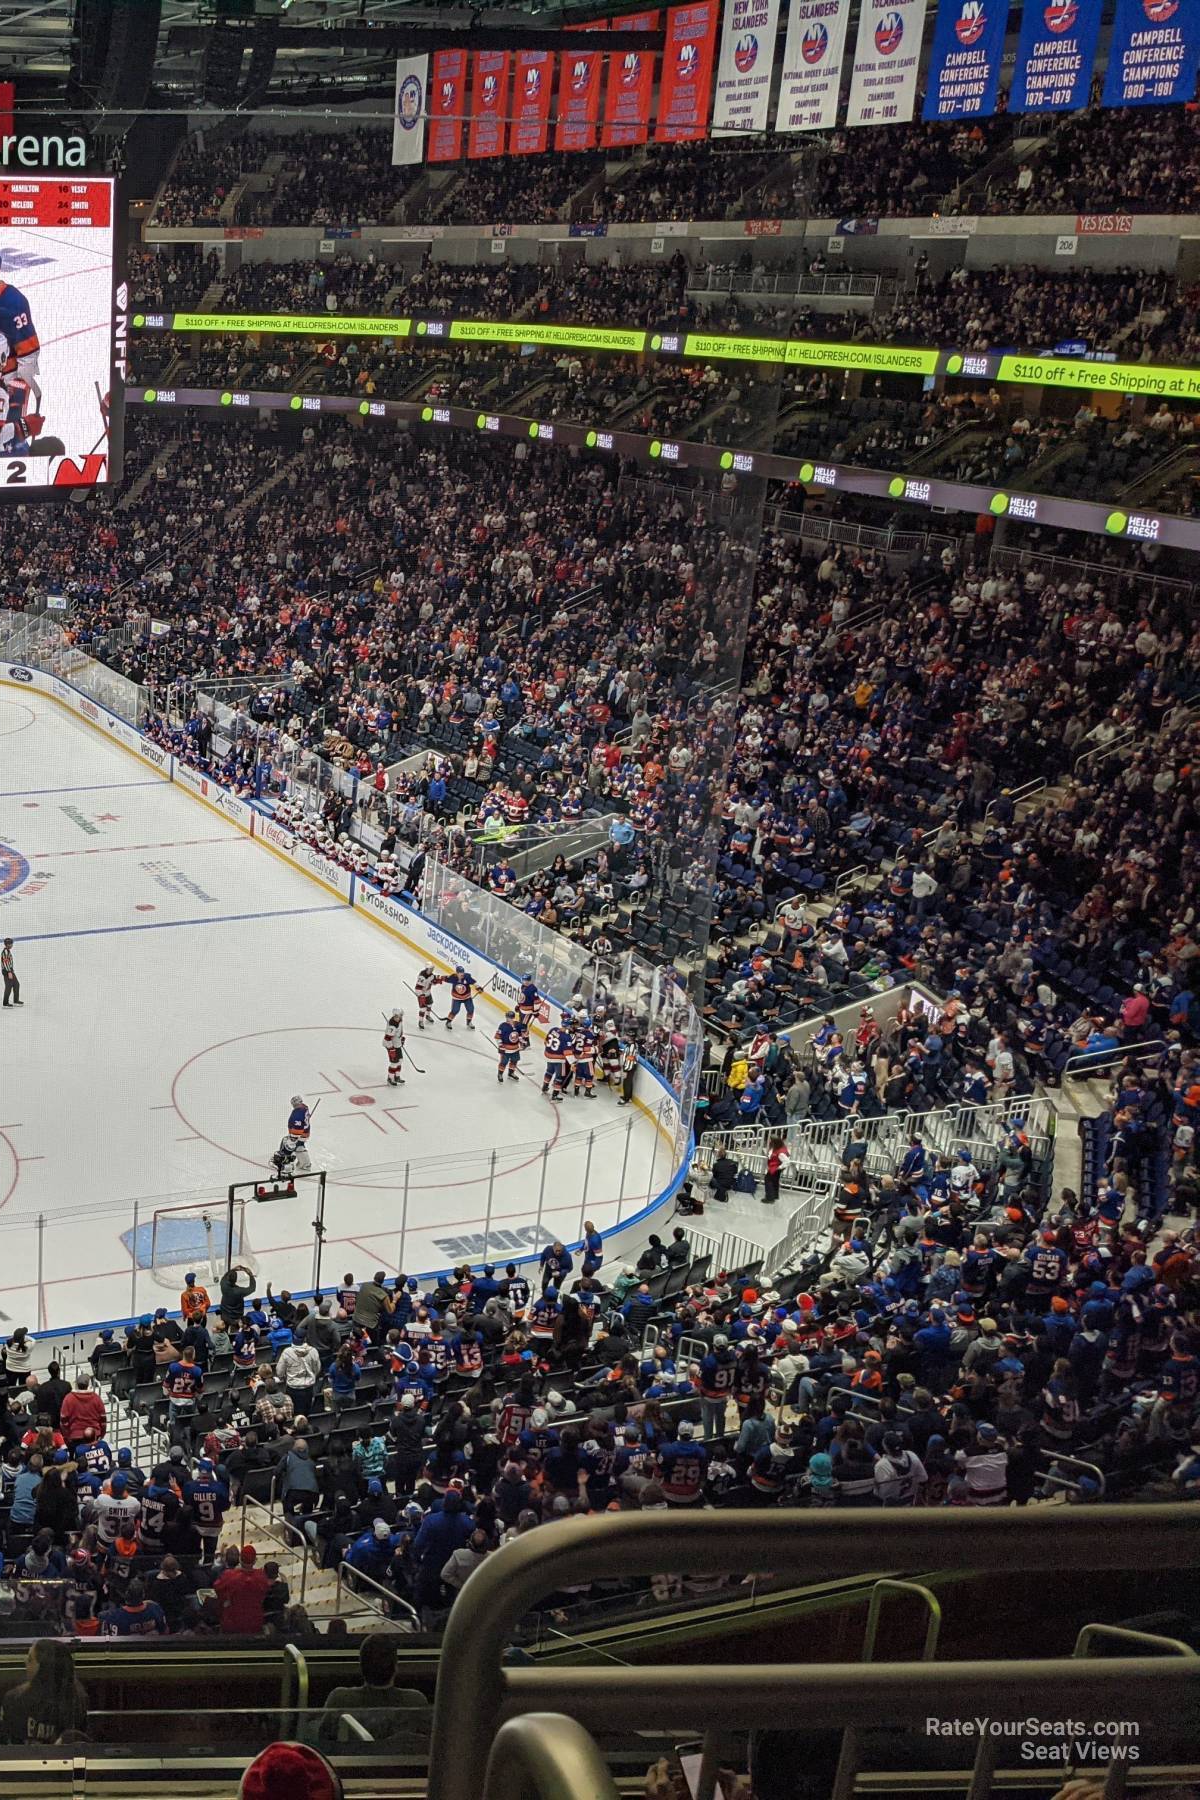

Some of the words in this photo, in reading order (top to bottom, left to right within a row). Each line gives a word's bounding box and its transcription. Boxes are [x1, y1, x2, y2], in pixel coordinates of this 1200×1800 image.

[800, 5, 839, 19] ISLANDERS
[732, 15, 768, 30] ISLANDERS
[1130, 28, 1182, 47] CAMPBELL
[1033, 39, 1077, 56] CAMPBELL
[1123, 45, 1185, 65] CONFERENCE
[855, 62, 877, 72] NATIONAL
[878, 60, 897, 70] HOCKEY
[898, 57, 917, 68] LEAGUE
[945, 53, 986, 66] CAMPBELL
[1026, 55, 1081, 73] CONFERENCE
[939, 65, 990, 82] CONFERENCE
[1122, 63, 1179, 82] CHAMPIONS
[1026, 73, 1076, 89] CHAMPIONS
[868, 91, 895, 102] CHAMPIONS
[939, 81, 985, 98] CHAMPIONS
[795, 99, 819, 109] CHAMPIONS
[11, 185, 39, 193] HAMILTON
[1080, 216, 1097, 231] YES
[1098, 216, 1114, 232] YES
[1116, 216, 1132, 232] YES
[1059, 241, 1073, 251] 206
[14, 313, 28, 328] 33
[205, 319, 218, 327] OFF
[227, 319, 245, 328] FREE
[247, 320, 281, 329] SHIPPING
[477, 328, 490, 337] OFF
[497, 328, 513, 337] FREE
[515, 329, 544, 339] SHIPPING
[545, 331, 551, 340] AT
[695, 341, 711, 351] $110
[712, 342, 726, 352] OFF
[733, 344, 750, 354] FREE
[751, 345, 785, 357] SHIPPING
[788, 348, 798, 358] AT
[964, 357, 987, 367] HELLO
[962, 365, 986, 375] FRESH
[1013, 364, 1042, 379] $110
[1045, 367, 1066, 380] off
[1078, 370, 1106, 385] Free
[1109, 372, 1165, 392] Shipping
[1169, 380, 1185, 392] at
[733, 462, 752, 471] FRESH
[734, 454, 752, 464] HELLO
[7, 461, 26, 484] 2
[815, 467, 836, 477] HELLO
[814, 475, 835, 485] FRESH
[907, 481, 930, 492] HELLO
[905, 489, 929, 500] FRESH
[1011, 498, 1037, 509] HELLO
[1009, 506, 1035, 518] FRESH
[1129, 516, 1159, 529] HELLO
[1126, 525, 1157, 539] FRESH
[140, 741, 167, 767] verizon
[308, 851, 339, 881] CardWorks
[21, 880, 49, 897] UBS
[427, 927, 471, 964] Jackpocket
[547, 1036, 560, 1051] 33
[432, 1225, 560, 1259] DIME
[1032, 1260, 1060, 1280] 53
[240, 1343, 256, 1355] 44
[173, 1377, 193, 1393] 27
[715, 1369, 735, 1388] 91
[671, 1466, 700, 1485] 29
[194, 1493, 216, 1501] GILLIES
[109, 1507, 128, 1516] SMITH
[203, 1502, 215, 1521] 9
